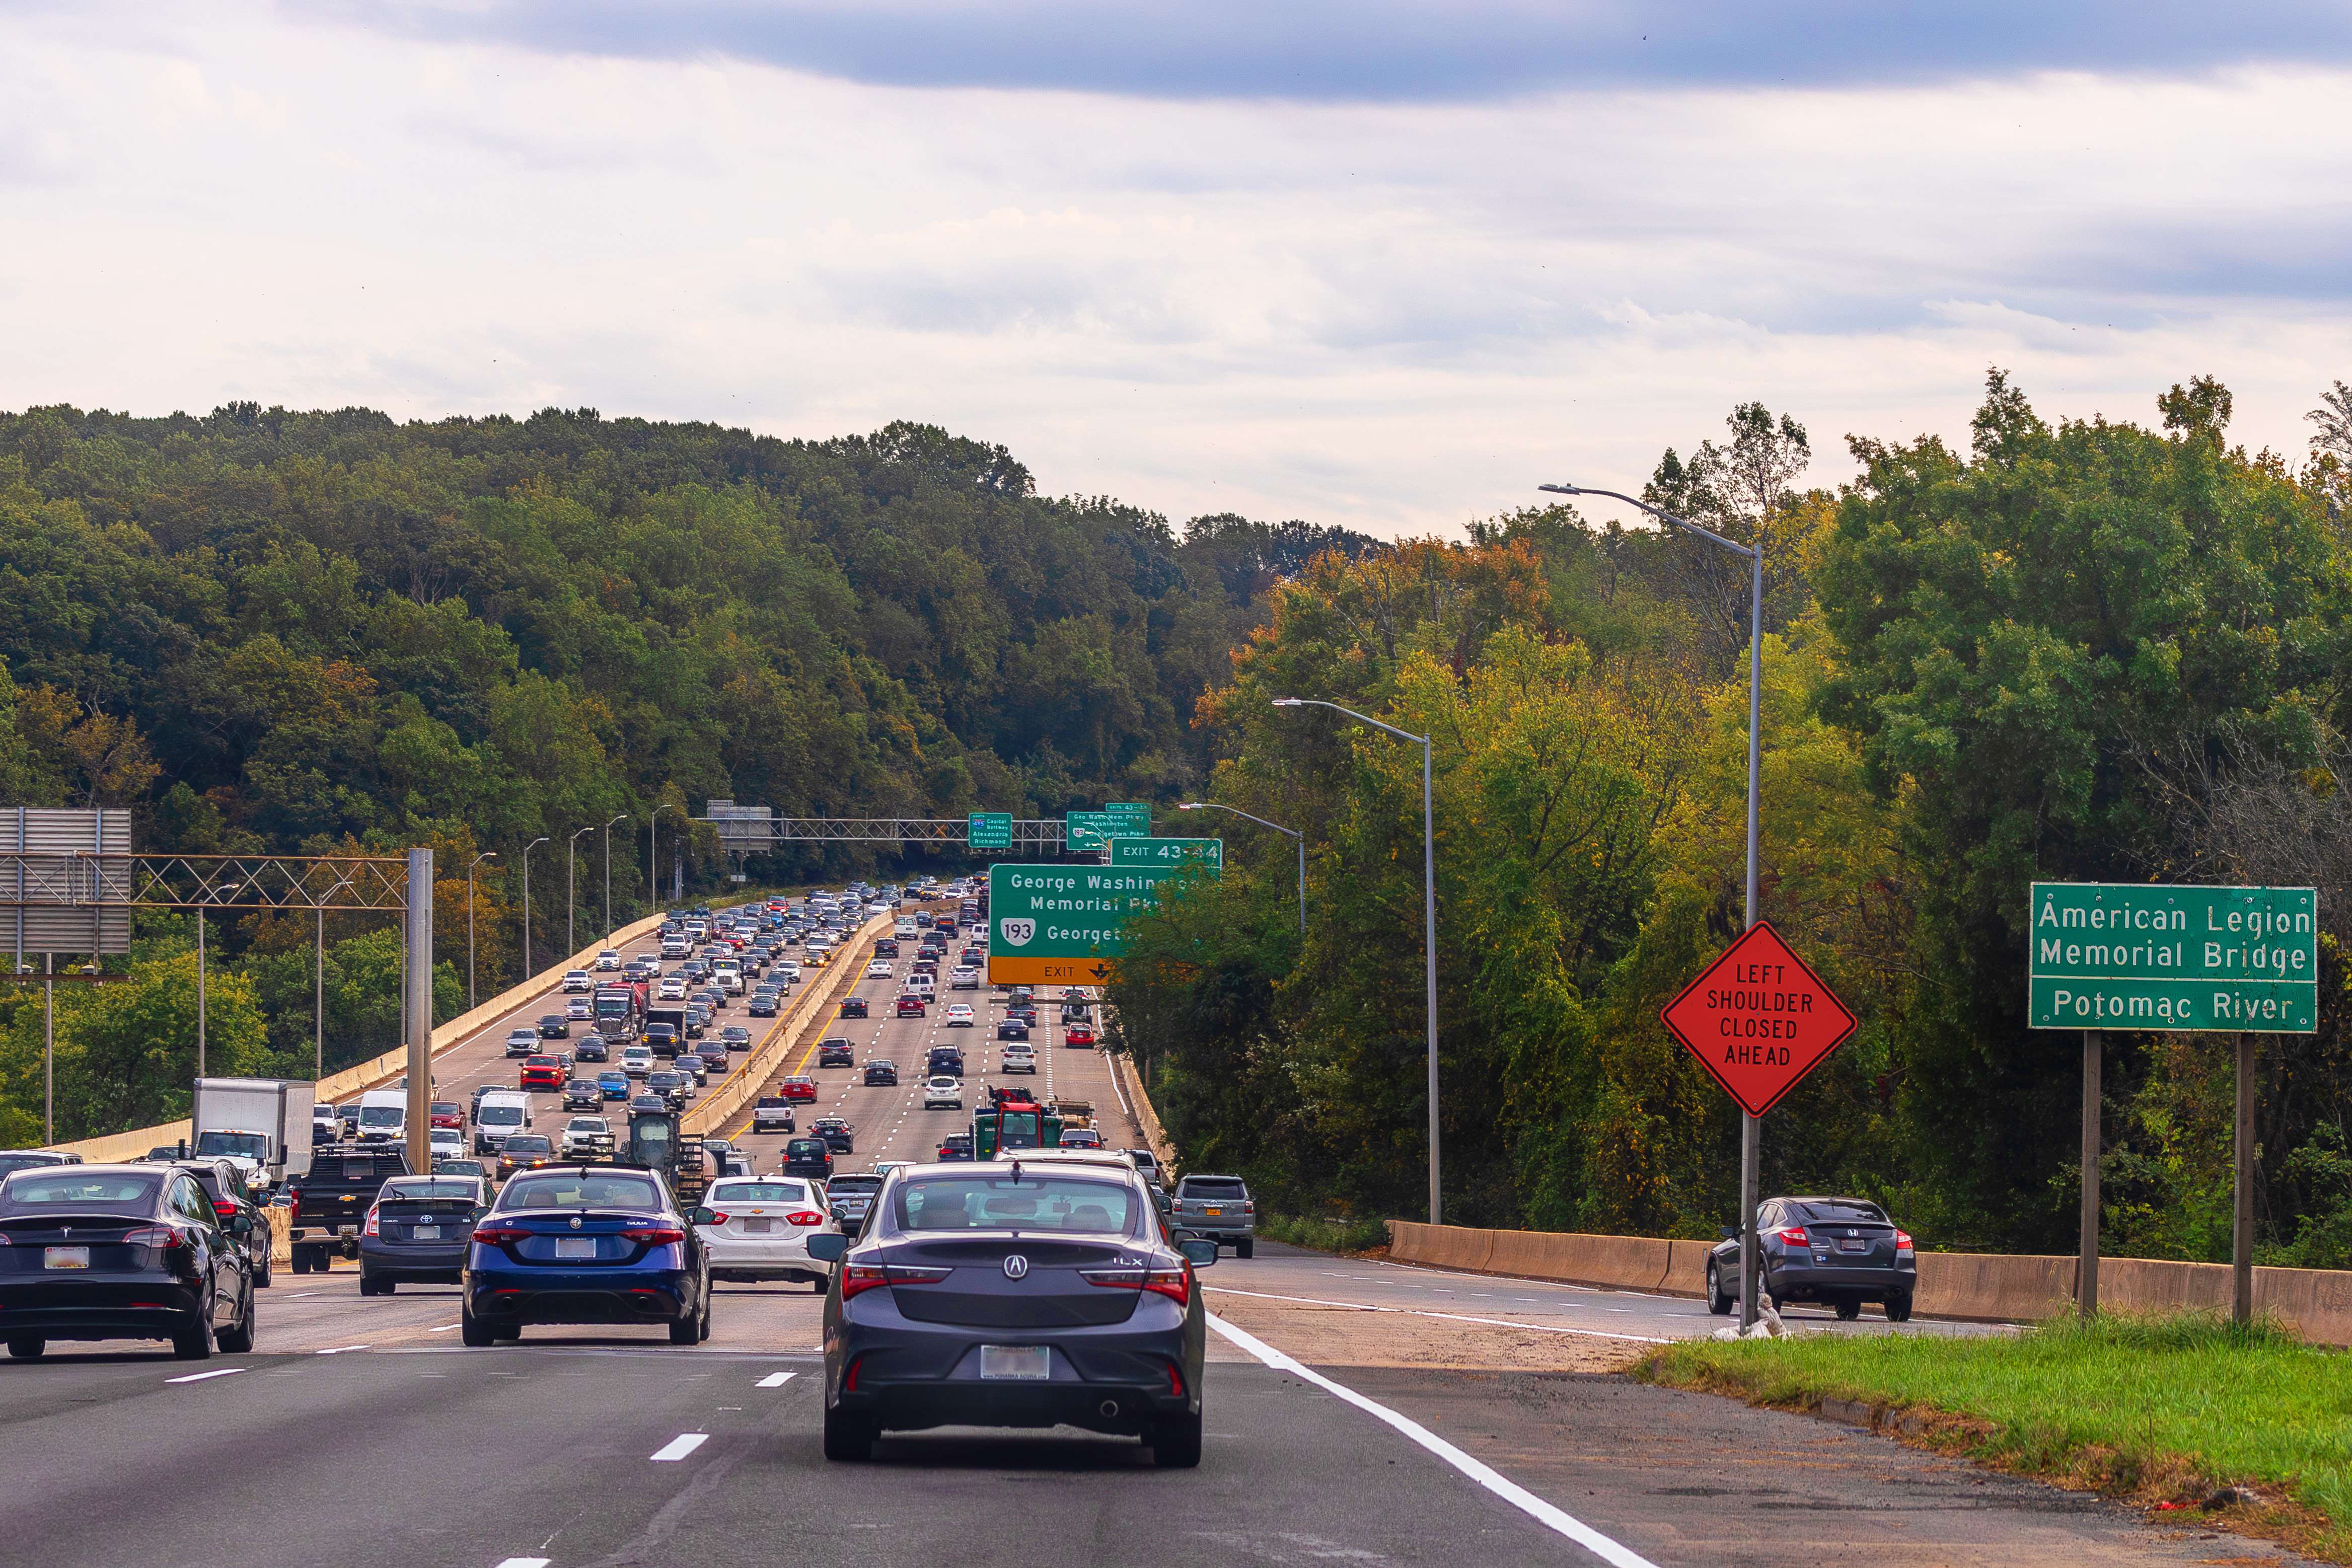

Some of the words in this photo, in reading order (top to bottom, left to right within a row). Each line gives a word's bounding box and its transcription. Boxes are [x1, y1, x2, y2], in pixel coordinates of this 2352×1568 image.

[1123, 847, 1149, 856] EXIT
[1011, 874, 1075, 892] George
[1031, 897, 1118, 911] Memorial
[1004, 924, 1031, 939] 193
[2038, 901, 2186, 931] American
[2208, 905, 2310, 940] Legion
[2040, 938, 2182, 967] Memorial
[2204, 940, 2306, 978] Bridge
[1044, 966, 1075, 977] EXIT
[1736, 963, 1785, 985] LEFT
[1707, 990, 1813, 1013] SHOULDER
[2054, 990, 2191, 1018] Potomac
[2214, 992, 2293, 1020] River
[1720, 1017, 1797, 1039] CLOSED
[1724, 1044, 1791, 1066] AHEAD
[1113, 1257, 1143, 1266] ILX
